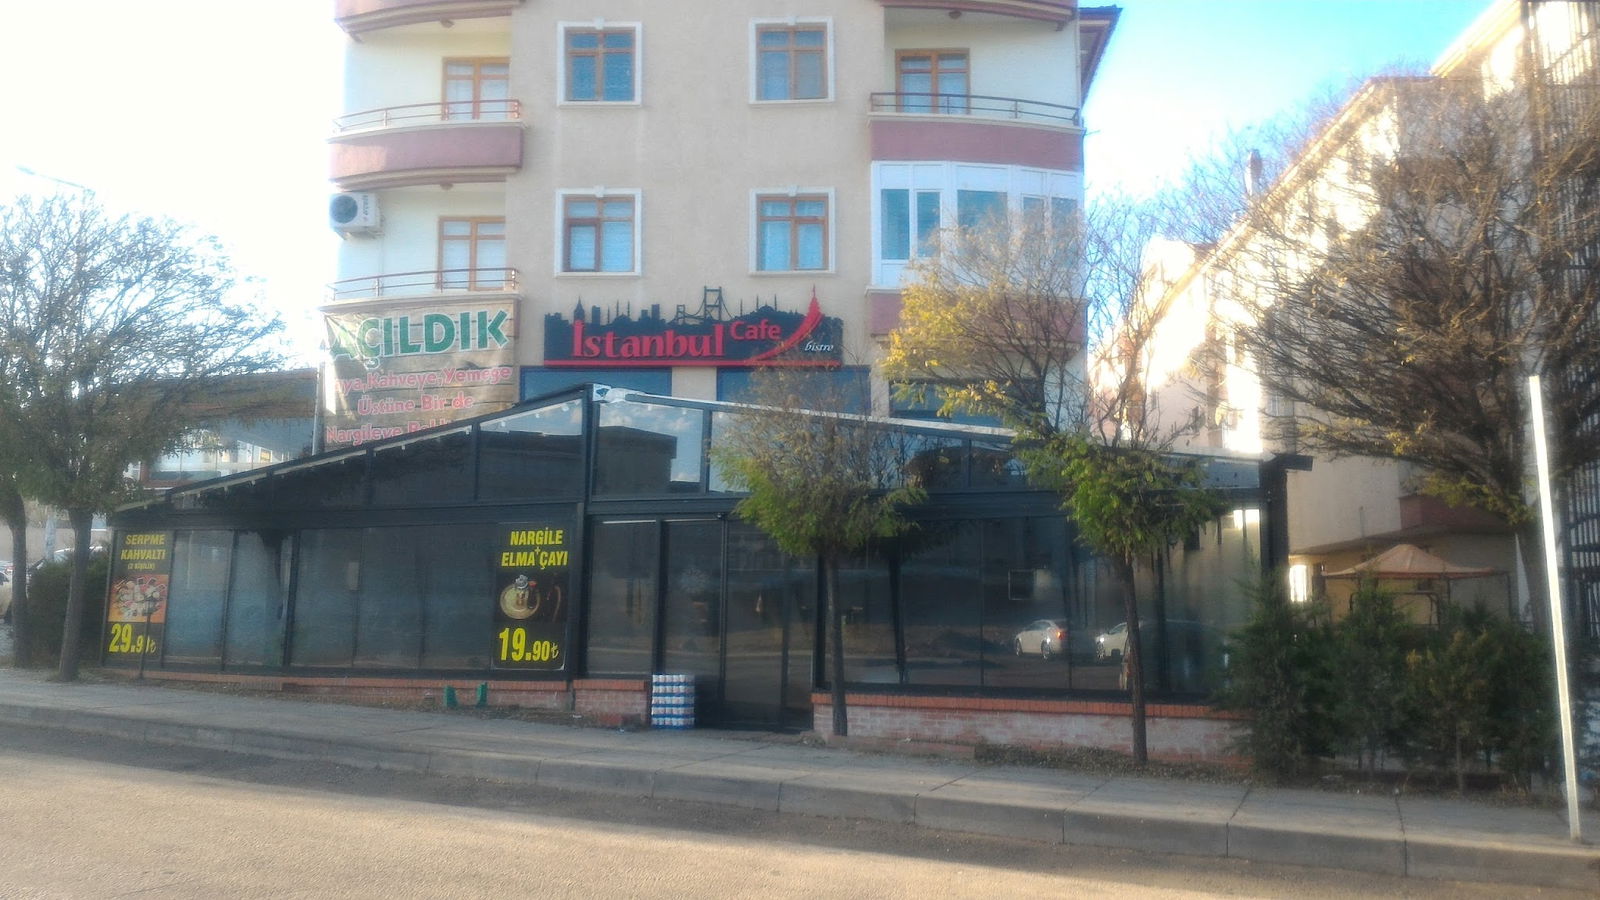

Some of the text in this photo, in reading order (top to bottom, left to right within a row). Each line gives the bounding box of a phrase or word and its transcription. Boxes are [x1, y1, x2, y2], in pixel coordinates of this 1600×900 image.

[329, 309, 509, 369] AÇILDIK
[730, 318, 782, 341] Cafe
[804, 341, 835, 353] bistro
[357, 391, 474, 416] Üstüne Bir de
[125, 534, 166, 545] SERPME
[509, 527, 564, 546] NARGİLE
[120, 548, 166, 561] KAHVALTI
[501, 550, 569, 569] ELMA ÇAYI
